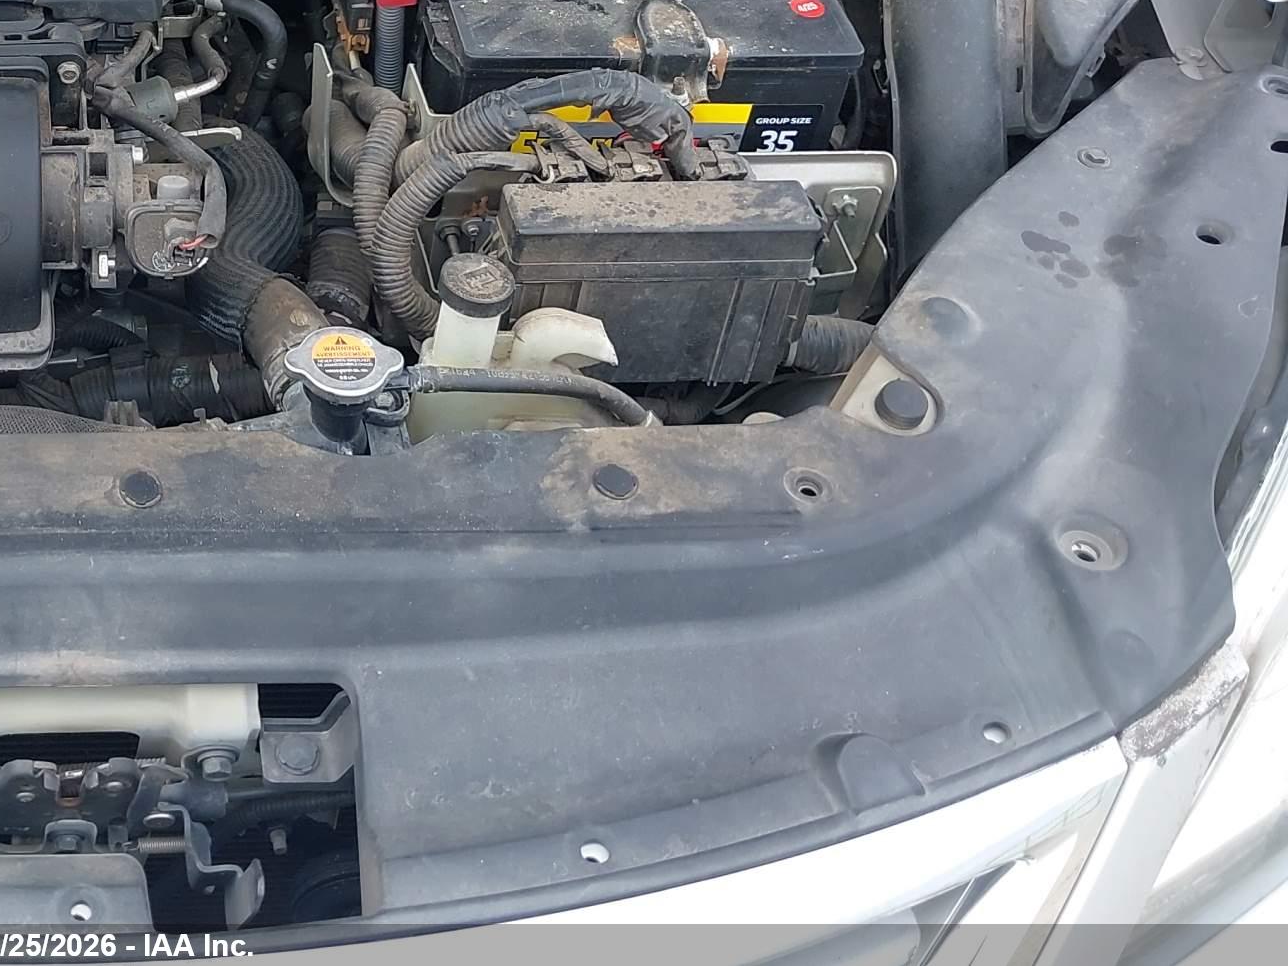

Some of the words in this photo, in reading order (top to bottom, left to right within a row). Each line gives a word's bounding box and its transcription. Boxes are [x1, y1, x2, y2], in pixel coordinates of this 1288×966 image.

[755, 117, 790, 125] GROUP
[790, 117, 813, 125] SIZE
[756, 129, 798, 153] 35
